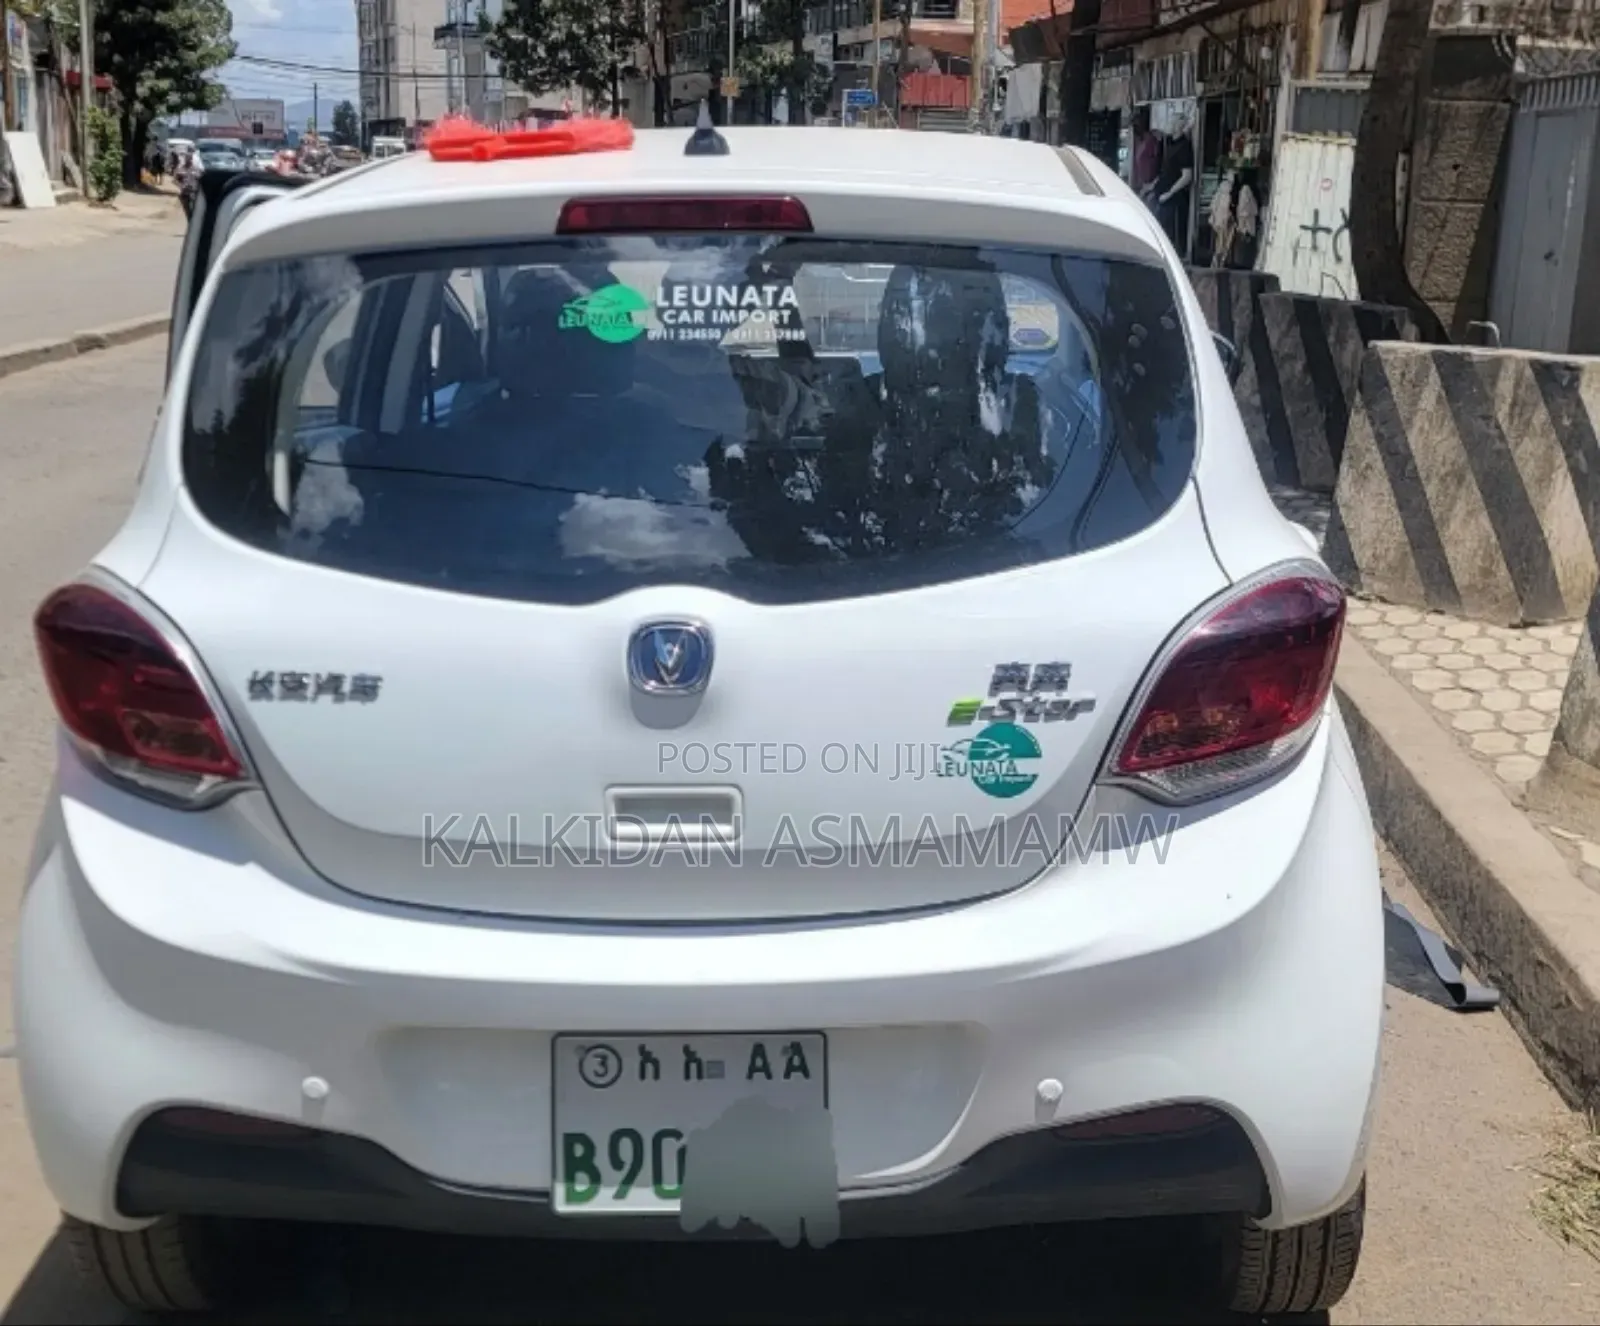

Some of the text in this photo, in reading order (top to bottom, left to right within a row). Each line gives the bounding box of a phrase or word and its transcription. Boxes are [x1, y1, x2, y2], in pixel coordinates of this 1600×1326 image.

[656, 285, 799, 307] LEUNATA
[663, 309, 791, 324] CAR IMPORT
[562, 1127, 688, 1206] B90
